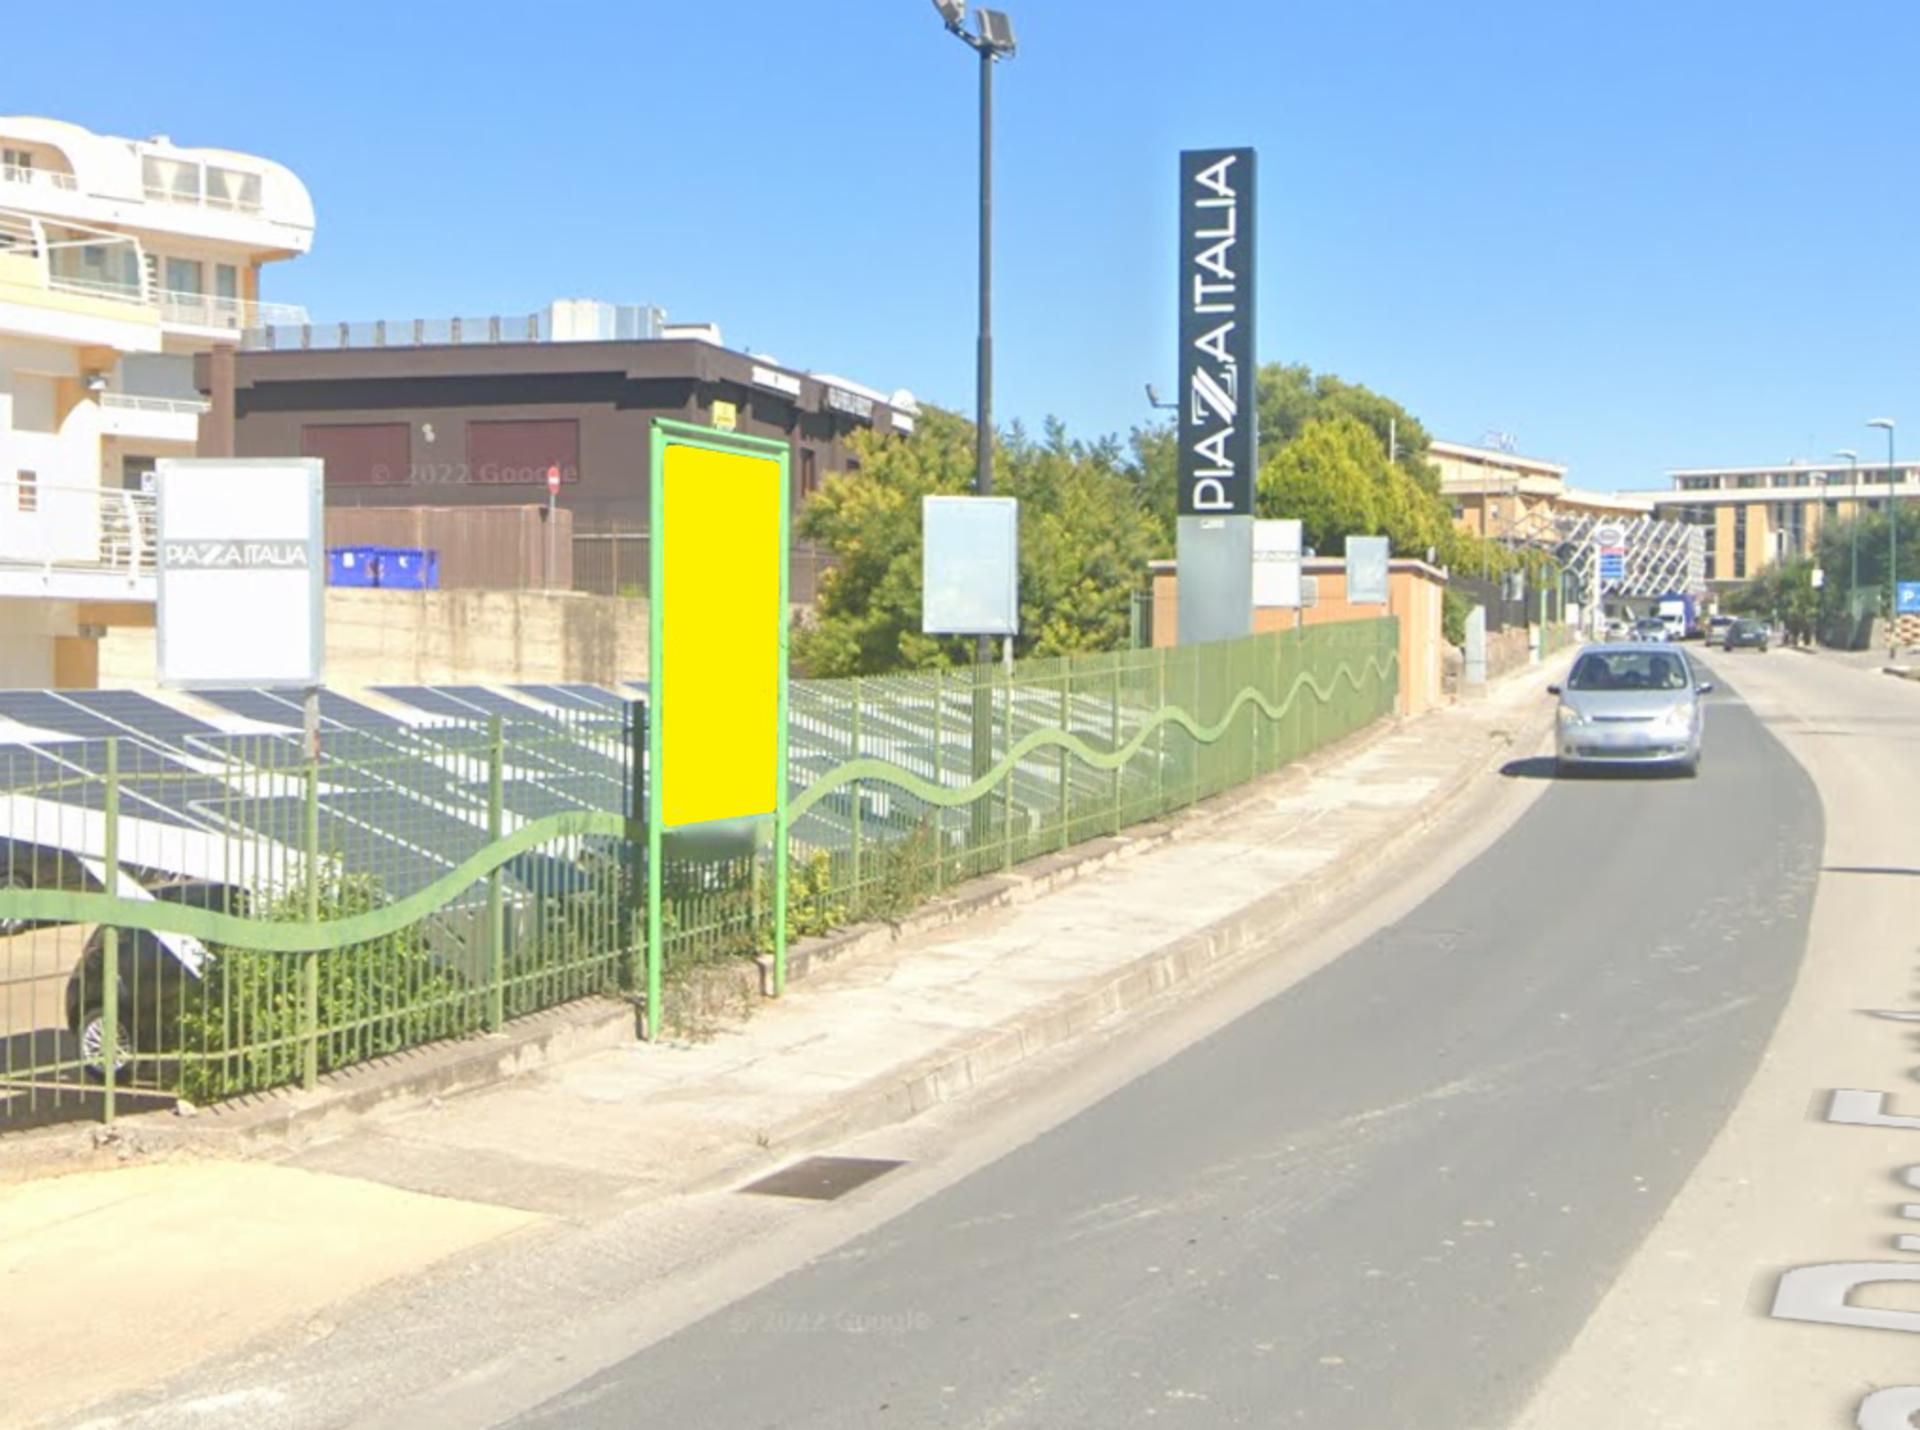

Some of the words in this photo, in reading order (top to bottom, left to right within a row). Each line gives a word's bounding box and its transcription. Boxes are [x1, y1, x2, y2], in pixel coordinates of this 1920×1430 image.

[1193, 154, 1237, 314] ITALIA
[1191, 321, 1238, 511] PIAZZA
[244, 544, 308, 565] ITALIA
